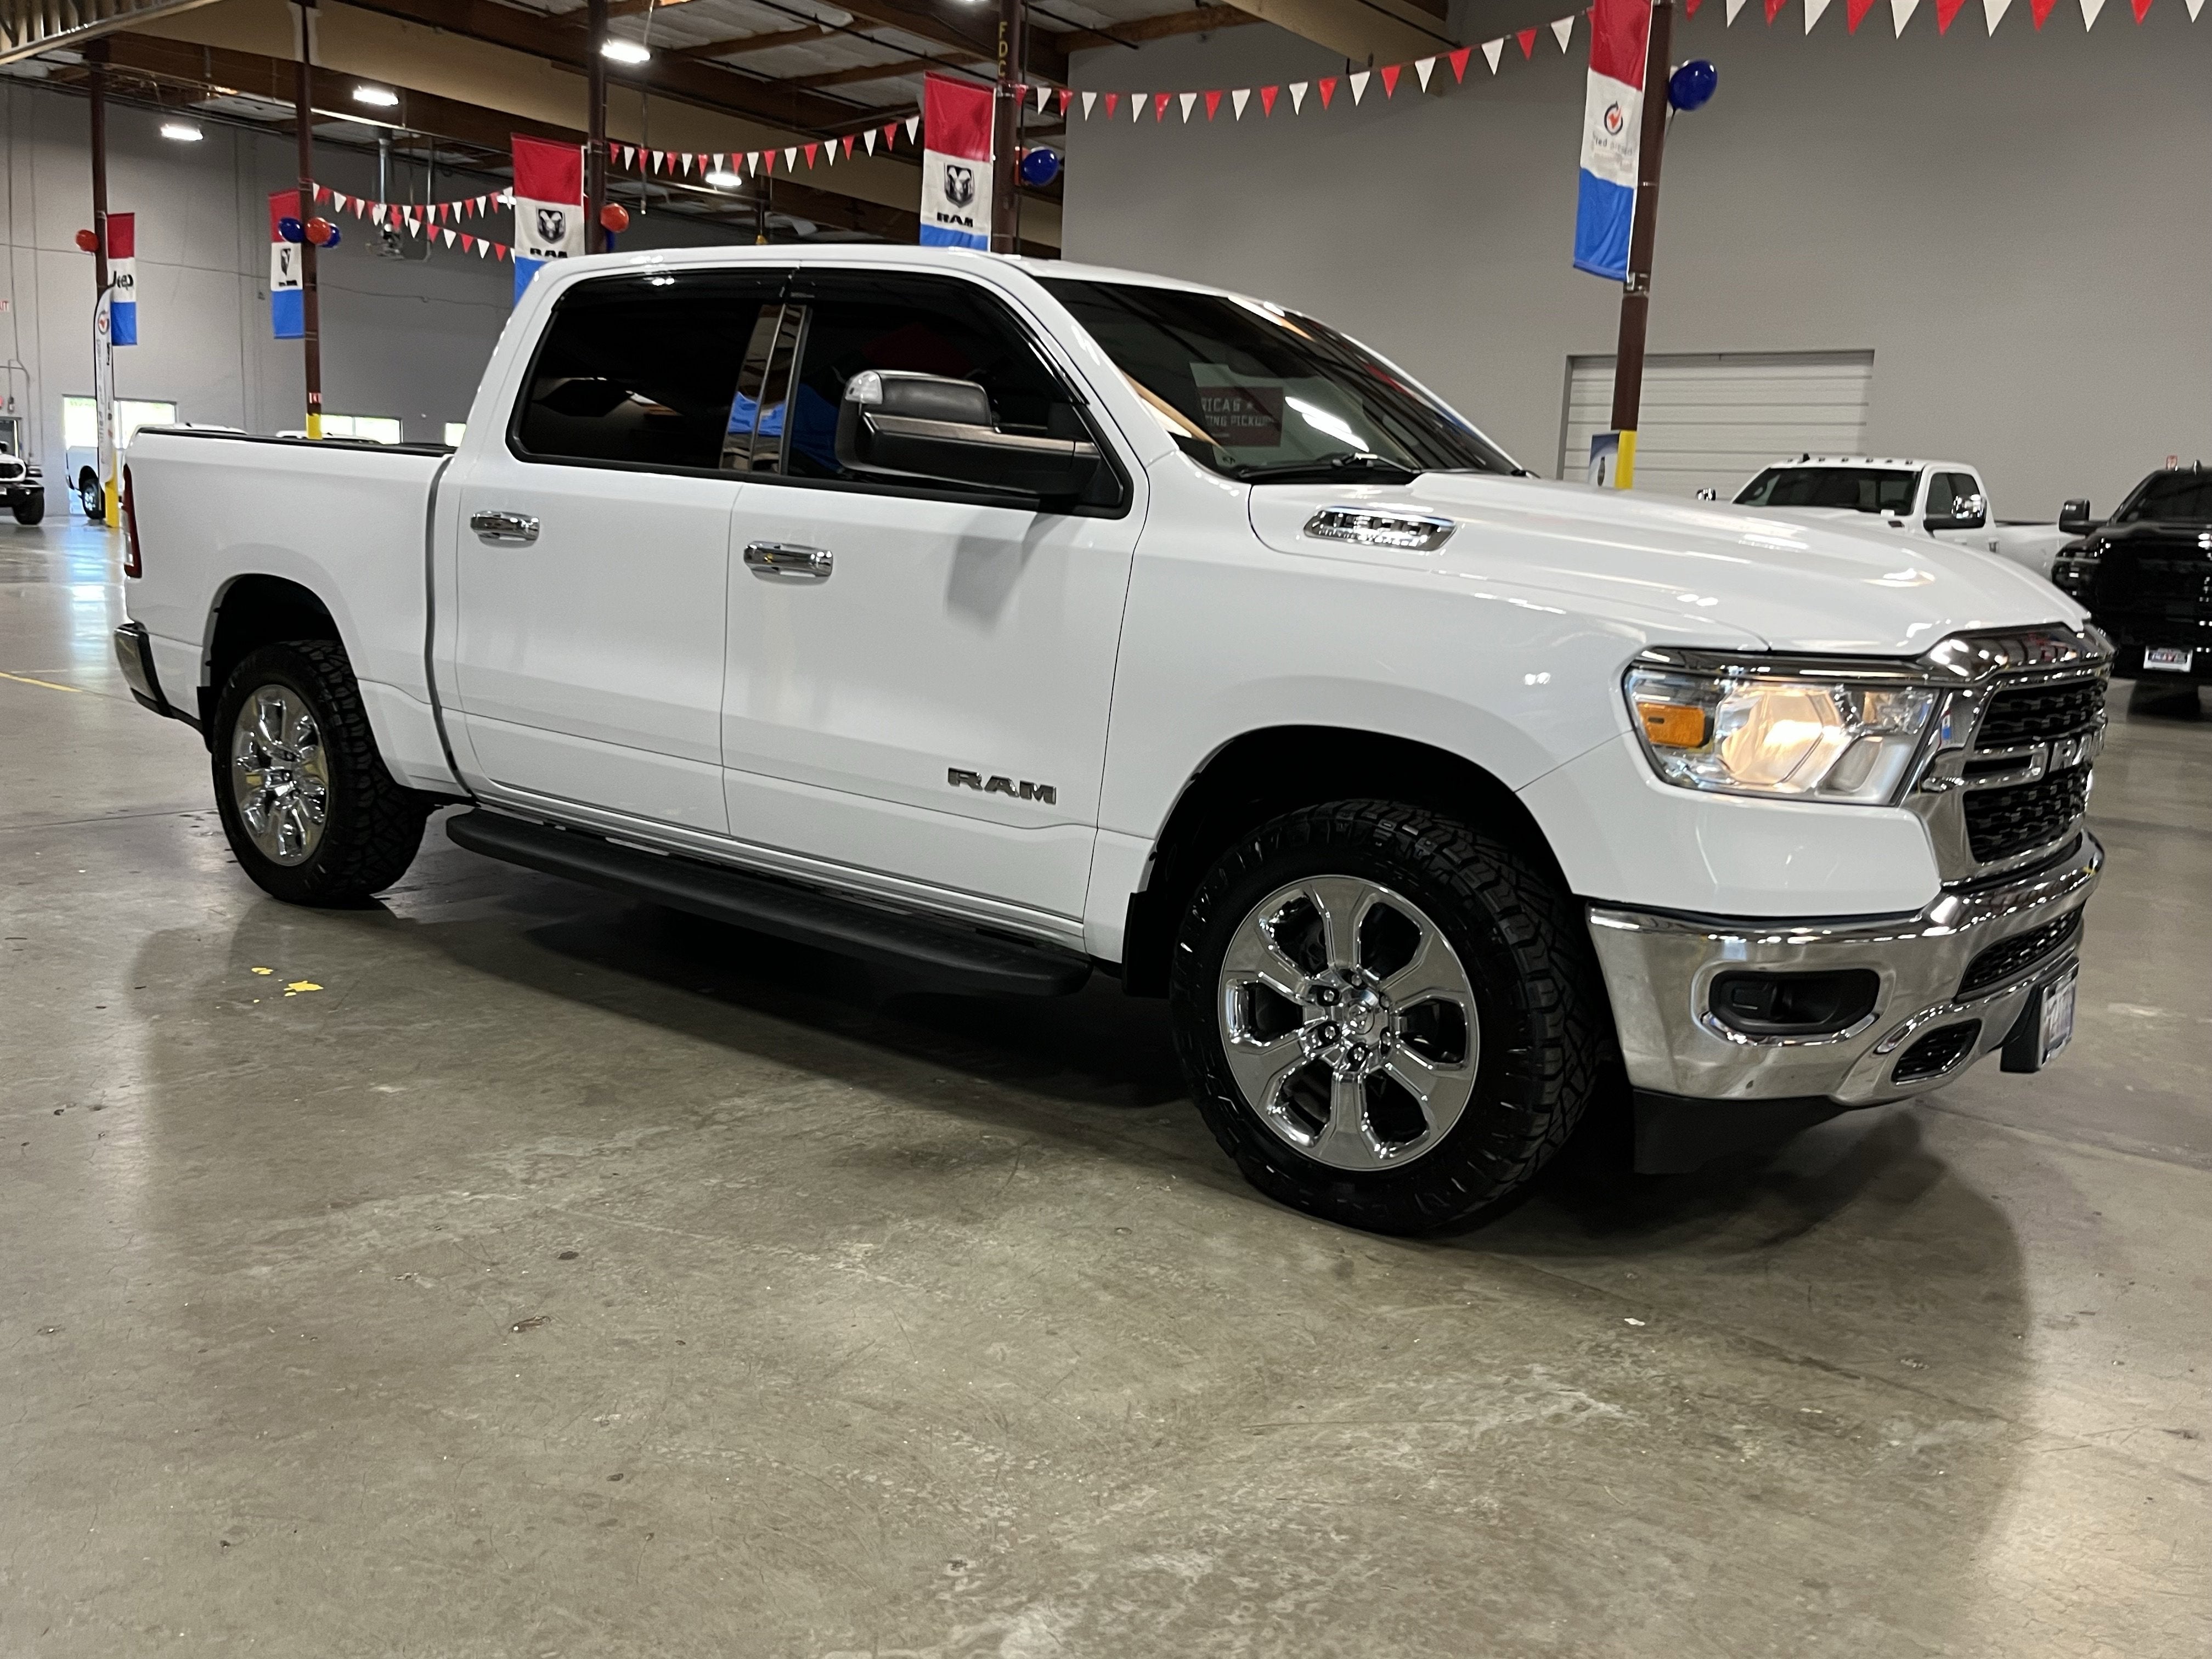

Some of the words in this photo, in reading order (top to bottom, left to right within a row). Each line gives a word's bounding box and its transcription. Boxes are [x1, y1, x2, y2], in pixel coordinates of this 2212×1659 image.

[998, 21, 1008, 76] FDC
[936, 212, 973, 228] RAM
[947, 767, 1057, 805] RAM
